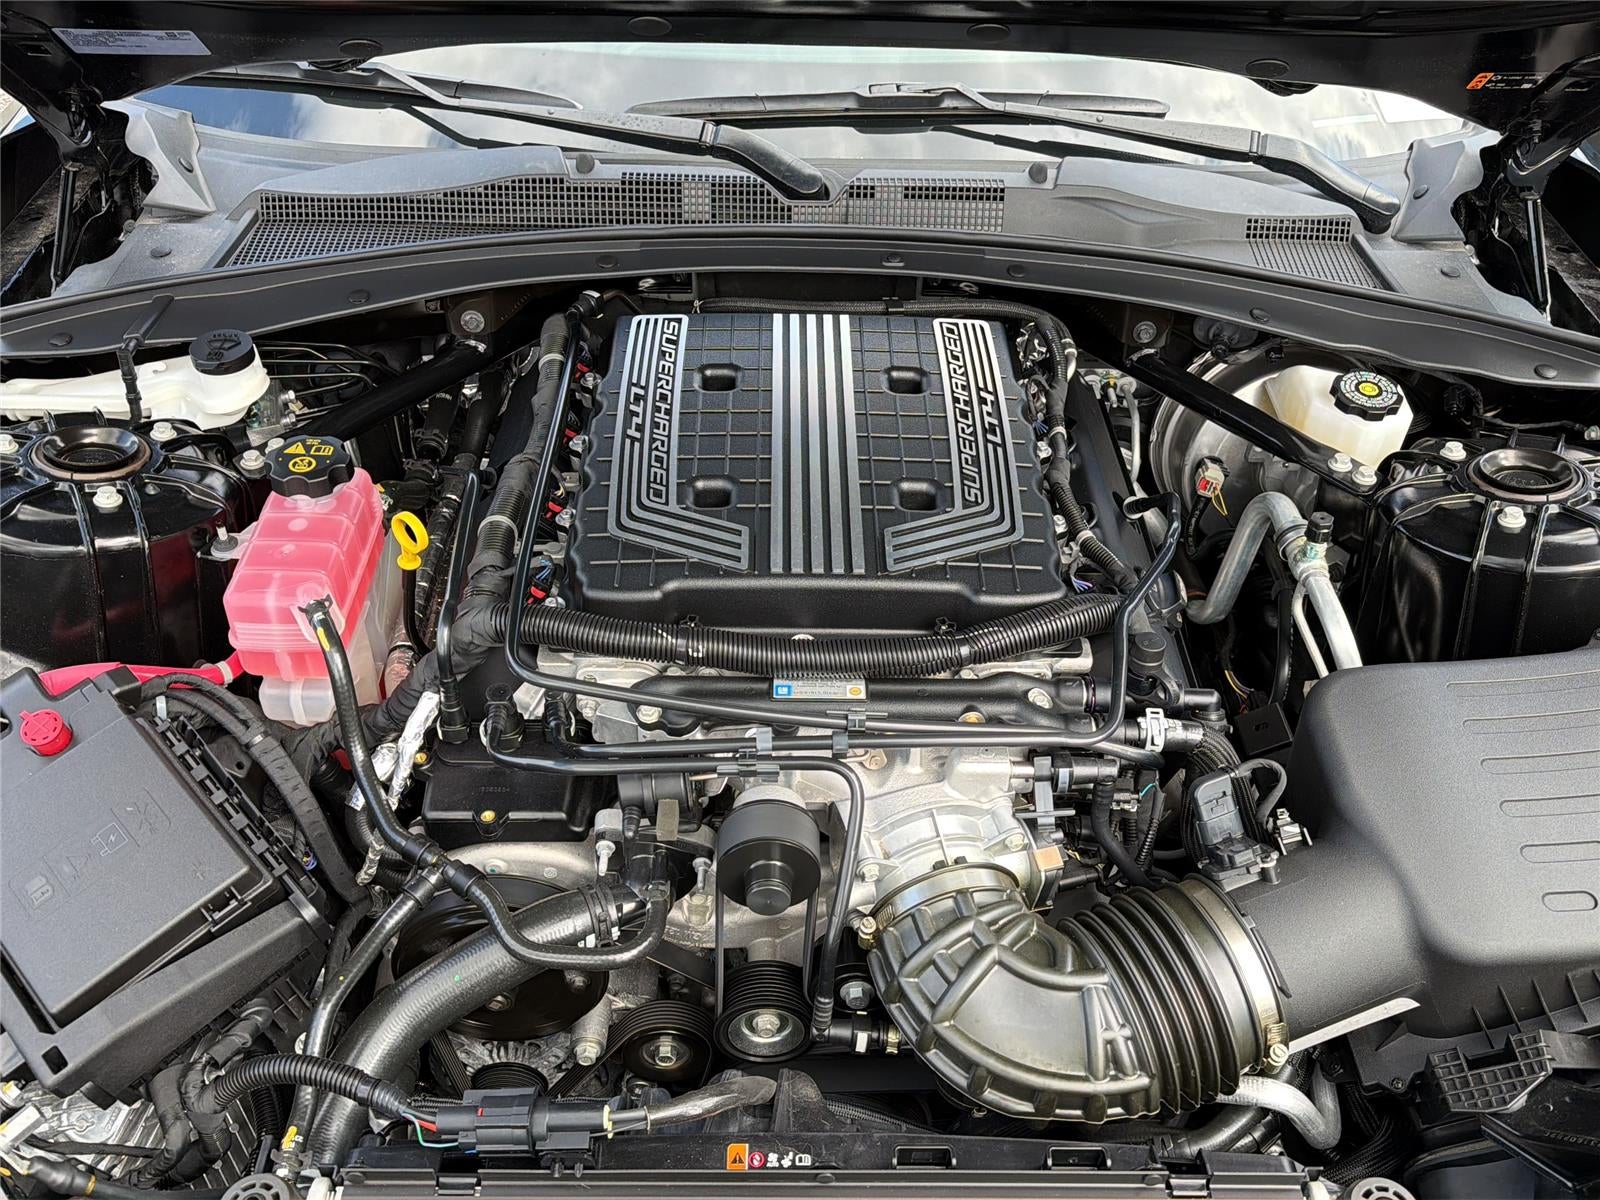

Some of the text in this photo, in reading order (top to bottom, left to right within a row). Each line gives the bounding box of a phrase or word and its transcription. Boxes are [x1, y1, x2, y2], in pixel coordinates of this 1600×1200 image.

[626, 387, 645, 439] LT4
[649, 319, 679, 504] SUPERCHARGED
[941, 322, 982, 504] SUPERCHARGED
[979, 390, 1002, 444] LT4
